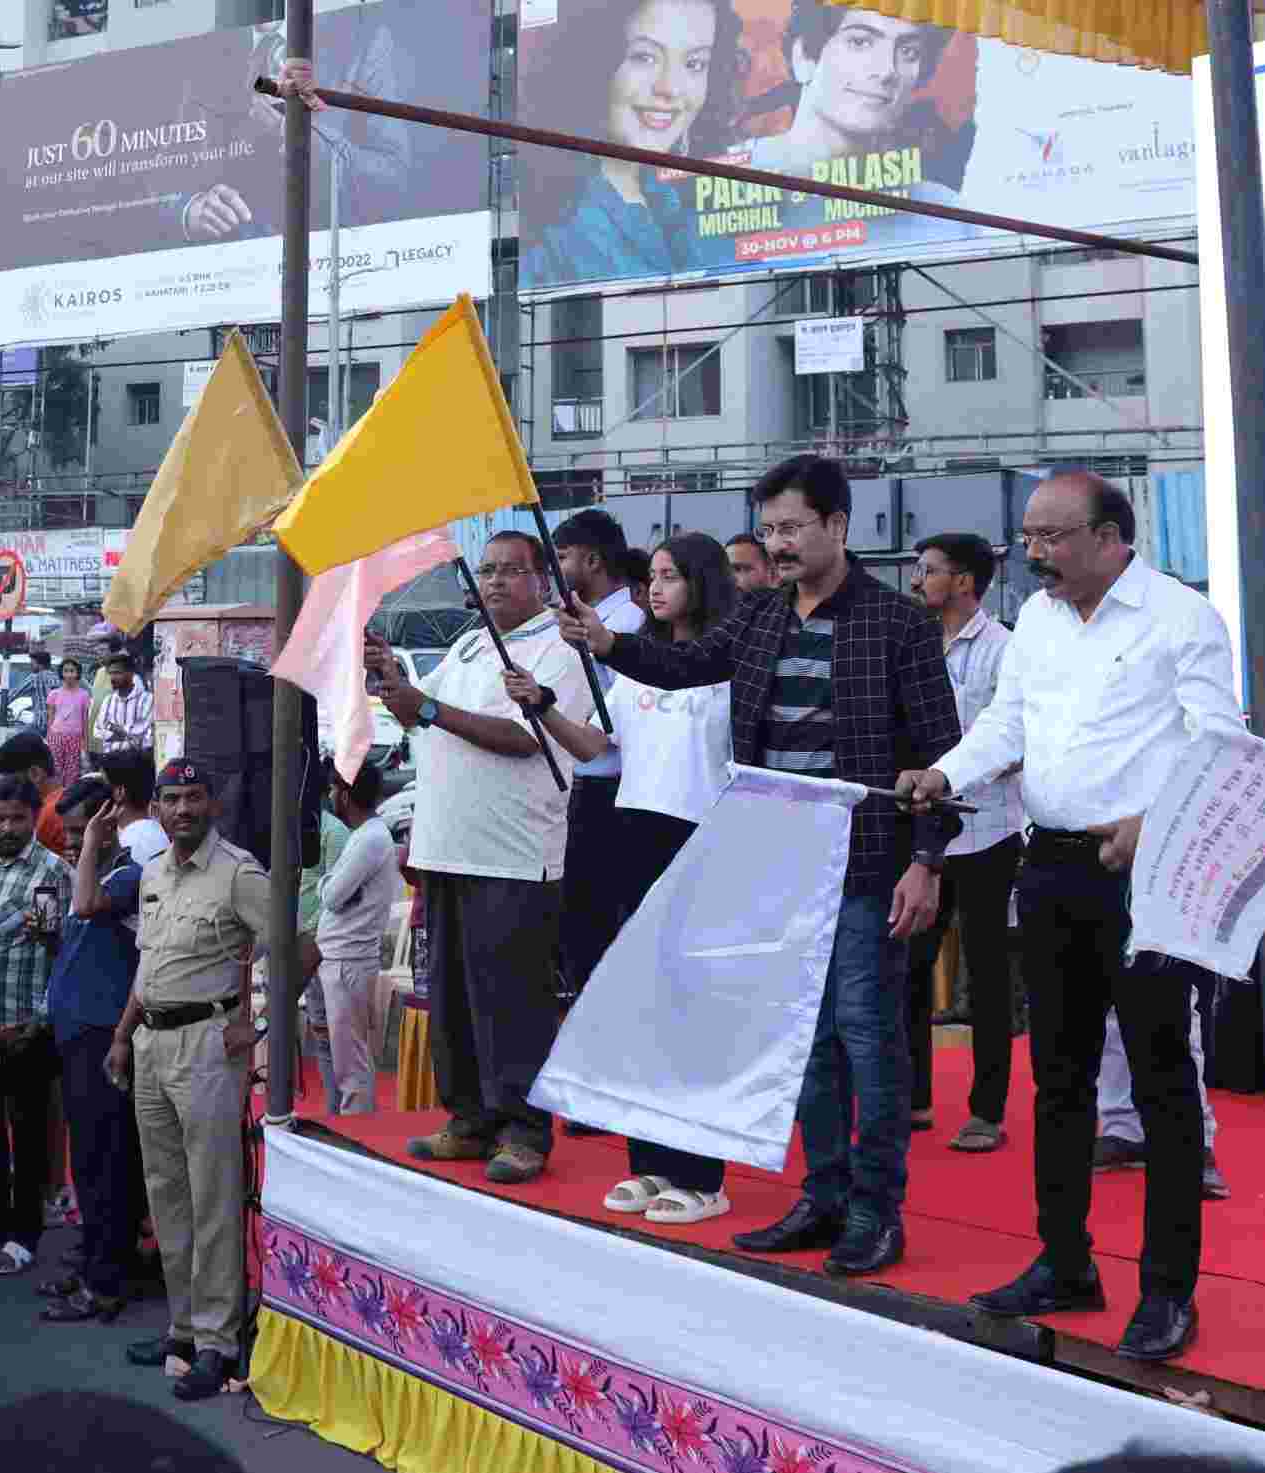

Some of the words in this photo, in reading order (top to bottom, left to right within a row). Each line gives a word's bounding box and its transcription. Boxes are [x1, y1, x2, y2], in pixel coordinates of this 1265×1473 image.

[27, 143, 67, 168] JUST
[72, 119, 117, 161] 60
[121, 120, 206, 152] MINUTES
[1118, 119, 1196, 163] vantag
[25, 175, 39, 189] at
[42, 172, 63, 184] our
[63, 166, 89, 181] site
[93, 160, 115, 177] will
[120, 151, 188, 175] transform
[190, 147, 226, 169] your
[813, 147, 921, 192] PALASH
[699, 206, 783, 236] MUCHHAL
[401, 244, 453, 262] LEGACY
[741, 235, 798, 255] 30-NOV
[836, 226, 863, 242] PM
[54, 287, 123, 309] KAIROS
